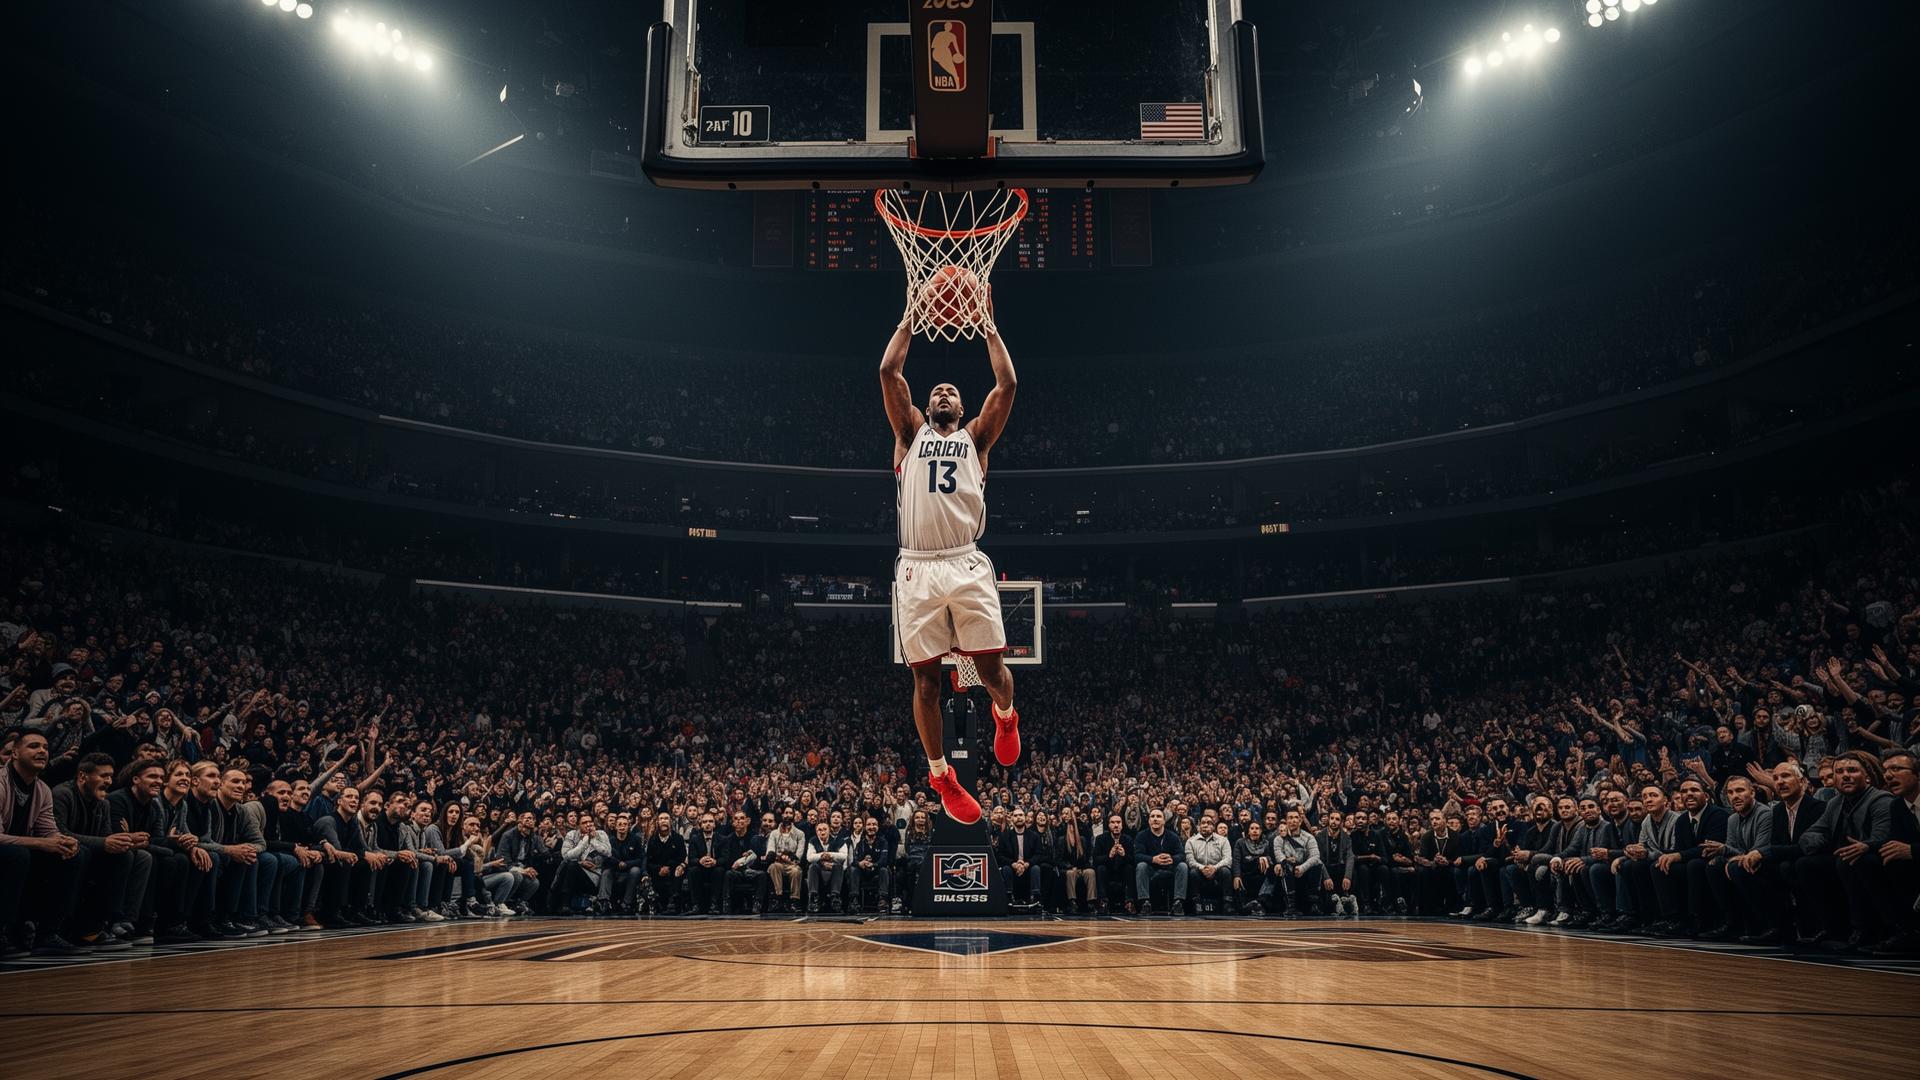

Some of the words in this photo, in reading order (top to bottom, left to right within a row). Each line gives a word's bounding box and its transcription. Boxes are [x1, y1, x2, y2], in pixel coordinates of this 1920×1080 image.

[934, 75, 955, 88] NBA
[732, 110, 753, 137] 10
[928, 460, 958, 494] 13
